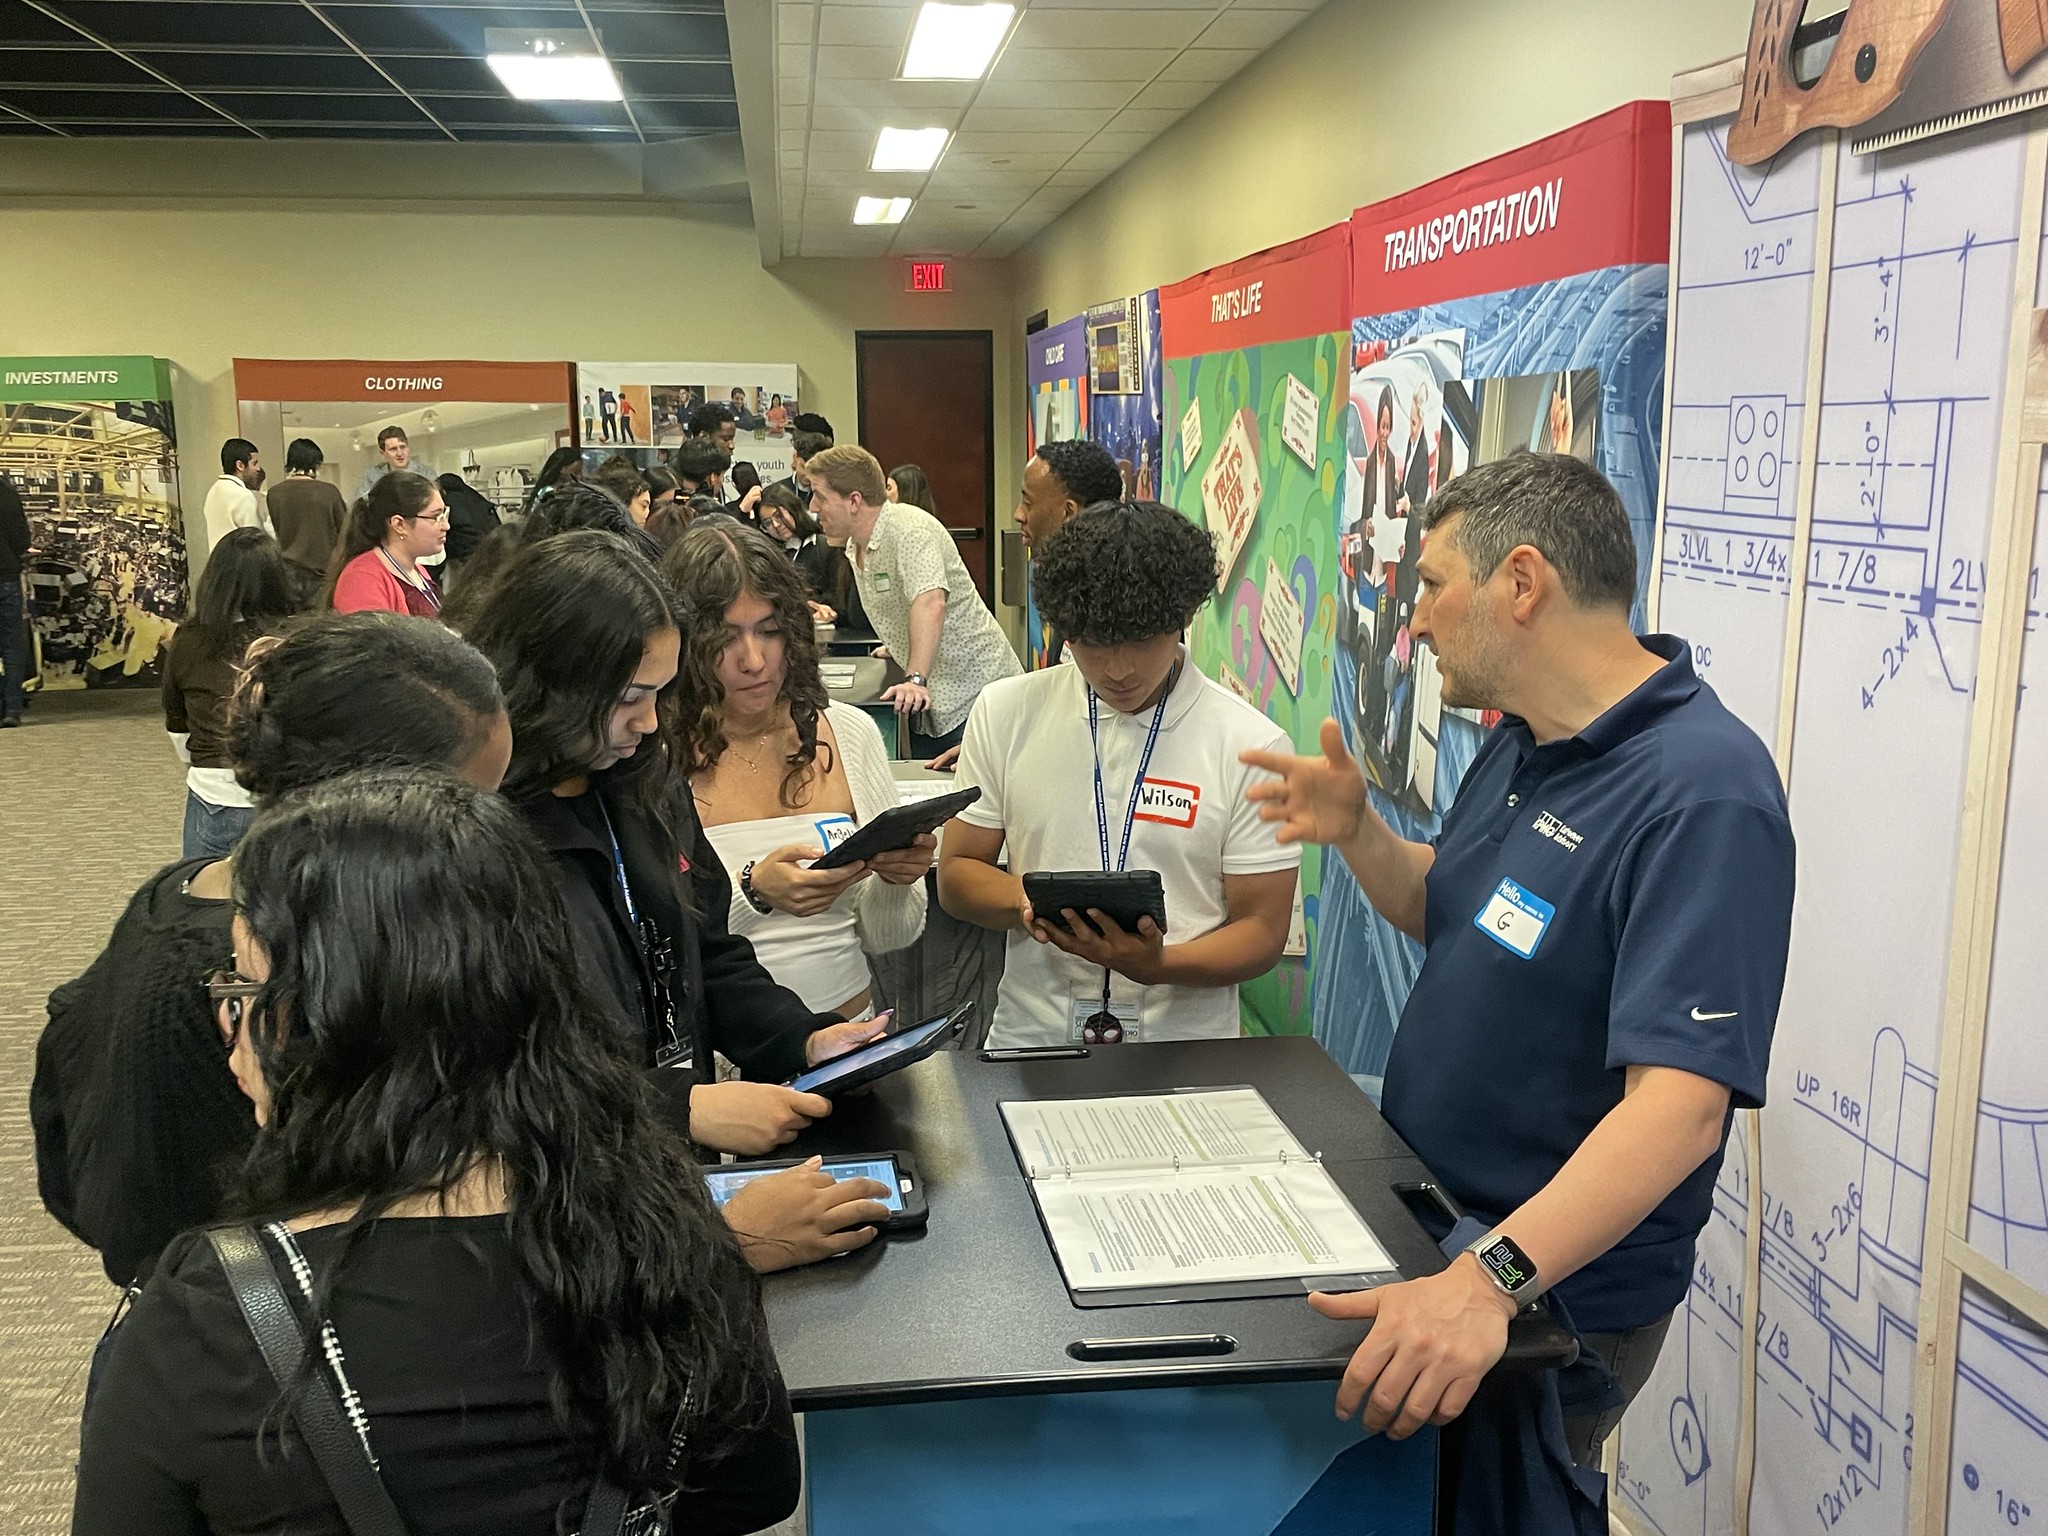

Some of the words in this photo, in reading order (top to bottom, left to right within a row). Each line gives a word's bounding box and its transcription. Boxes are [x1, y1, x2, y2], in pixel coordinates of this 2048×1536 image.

[1384, 177, 1563, 273] TRANSPORTATION
[1744, 238, 1793, 271] 12'-0"
[913, 264, 945, 289] EXIT
[1211, 289, 1240, 323] THAT'S
[1241, 281, 1263, 317] LIFE
[5, 370, 119, 385] INVESTMENTS
[365, 377, 443, 390] CLOTHING
[757, 459, 785, 471] youth
[1678, 533, 1713, 564] 3LVL
[1744, 539, 1787, 575] 3/4x
[1838, 548, 1877, 589] 7/8
[1142, 788, 1191, 810] Wilson
[1498, 879, 1521, 903] Hello
[1497, 911, 1514, 931] G
[1796, 1069, 1820, 1098] UP
[1832, 1090, 1862, 1128] 16R
[1681, 1418, 1692, 1454] A
[1817, 1464, 1863, 1532] 12x12
